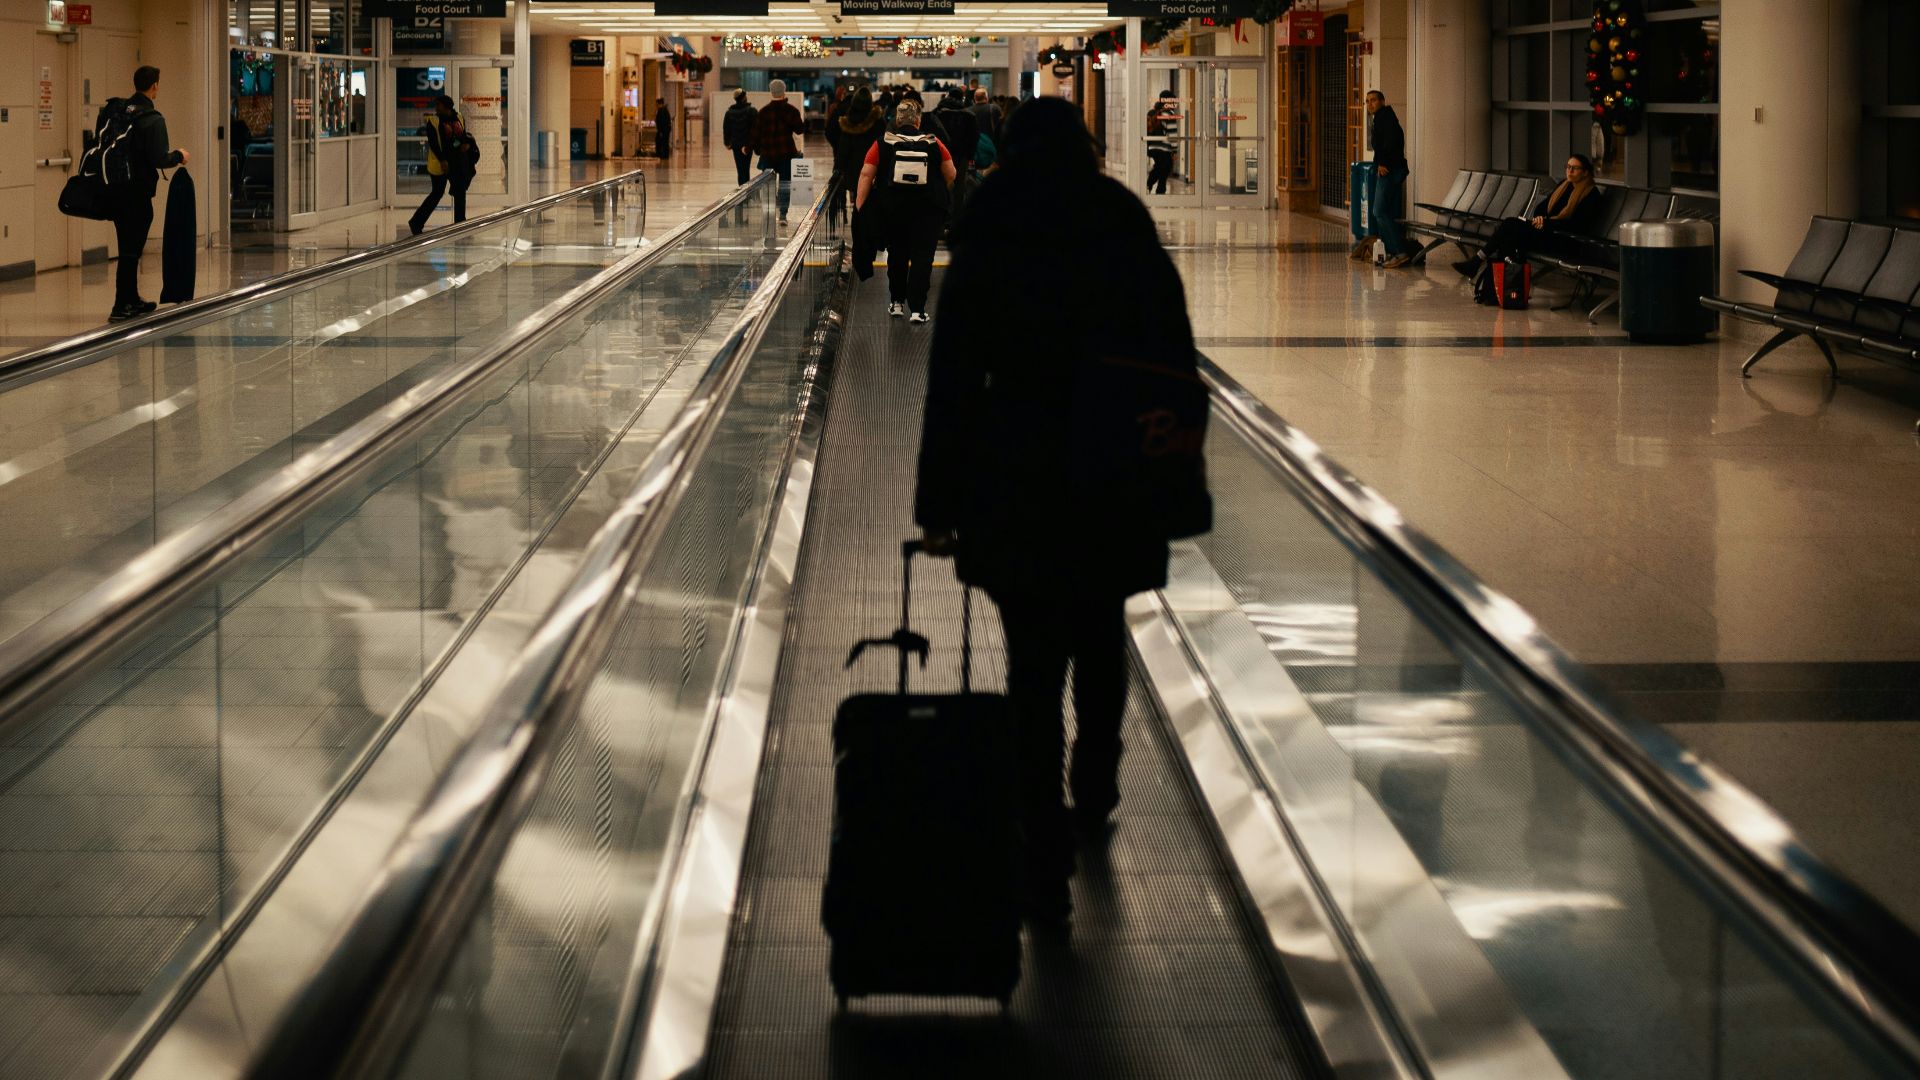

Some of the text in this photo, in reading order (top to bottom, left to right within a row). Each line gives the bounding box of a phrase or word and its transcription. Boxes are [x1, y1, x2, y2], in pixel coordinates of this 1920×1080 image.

[415, 5, 471, 14] Food Court
[843, 0, 953, 10] Moving Walkway Ends
[1161, 5, 1216, 14] Food Court
[395, 32, 434, 40] Concourse
[587, 42, 604, 53] B1
